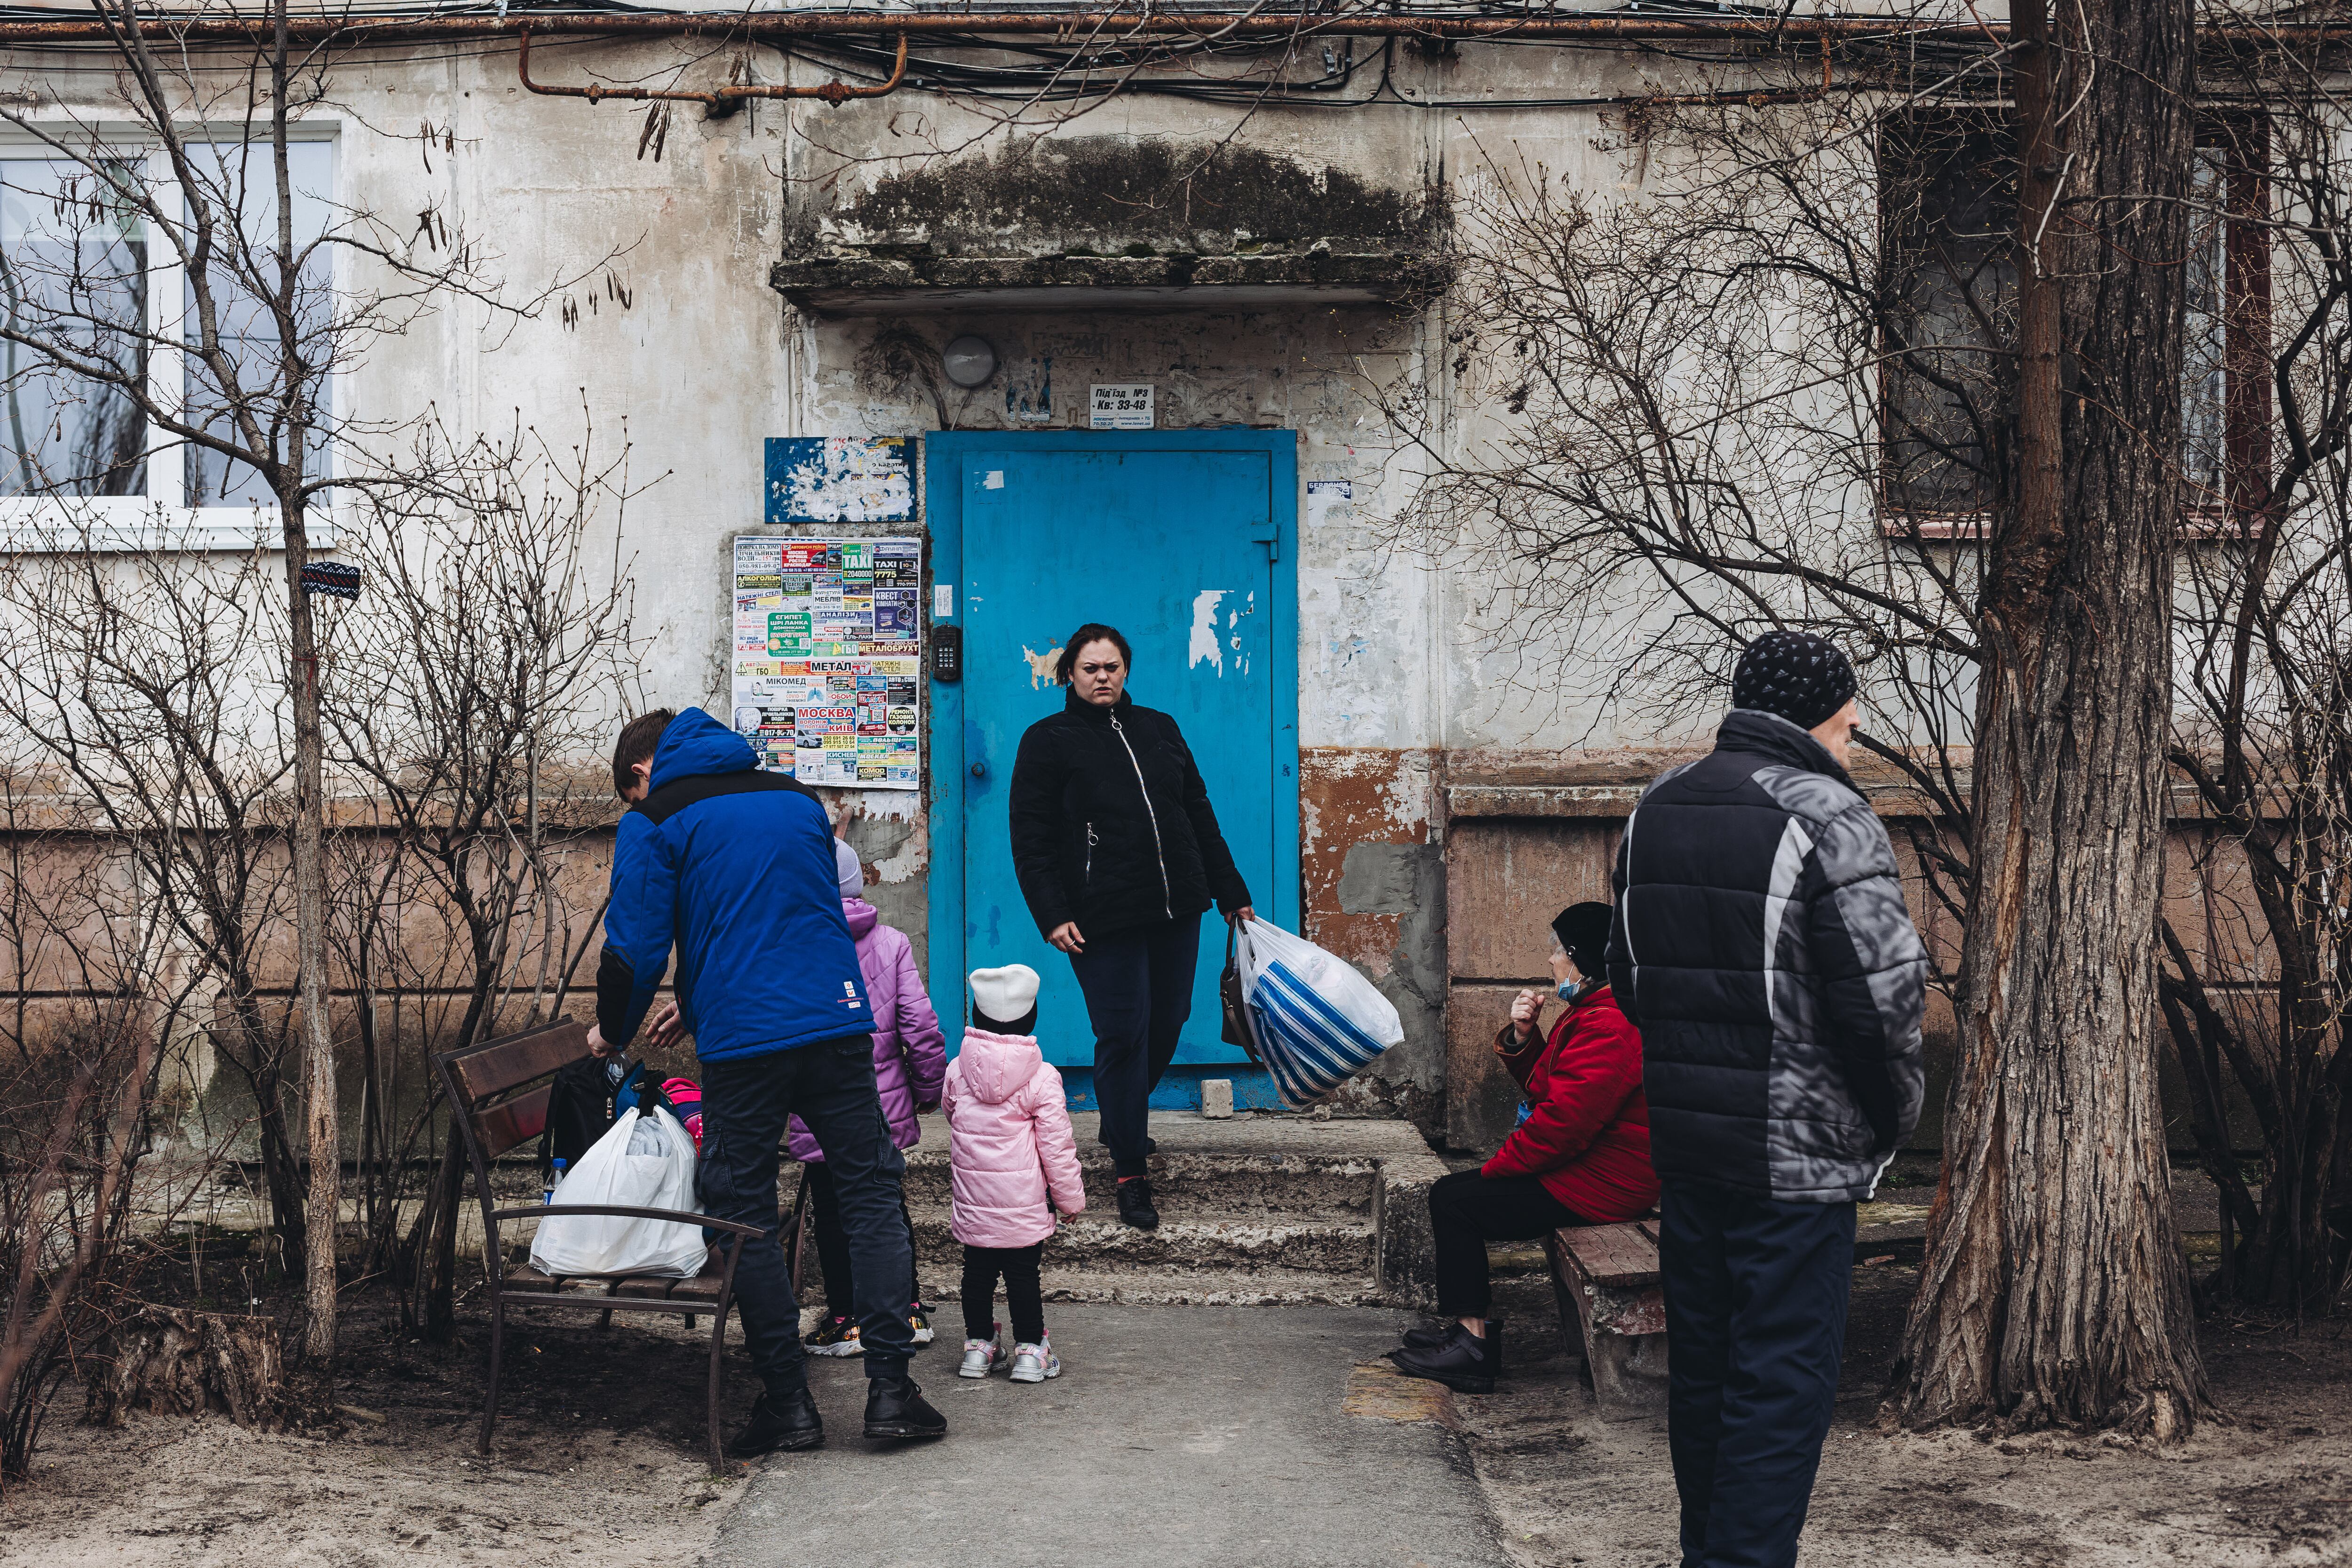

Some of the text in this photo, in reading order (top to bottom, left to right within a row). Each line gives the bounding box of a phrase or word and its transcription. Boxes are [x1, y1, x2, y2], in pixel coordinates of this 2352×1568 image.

[1133, 389, 1148, 397] №3
[1097, 400, 1146, 410] Кв: 33-48
[842, 644, 857, 654] ГБО
[811, 662, 852, 671] МЕТАЛ
[799, 708, 854, 717] МОСКВА
